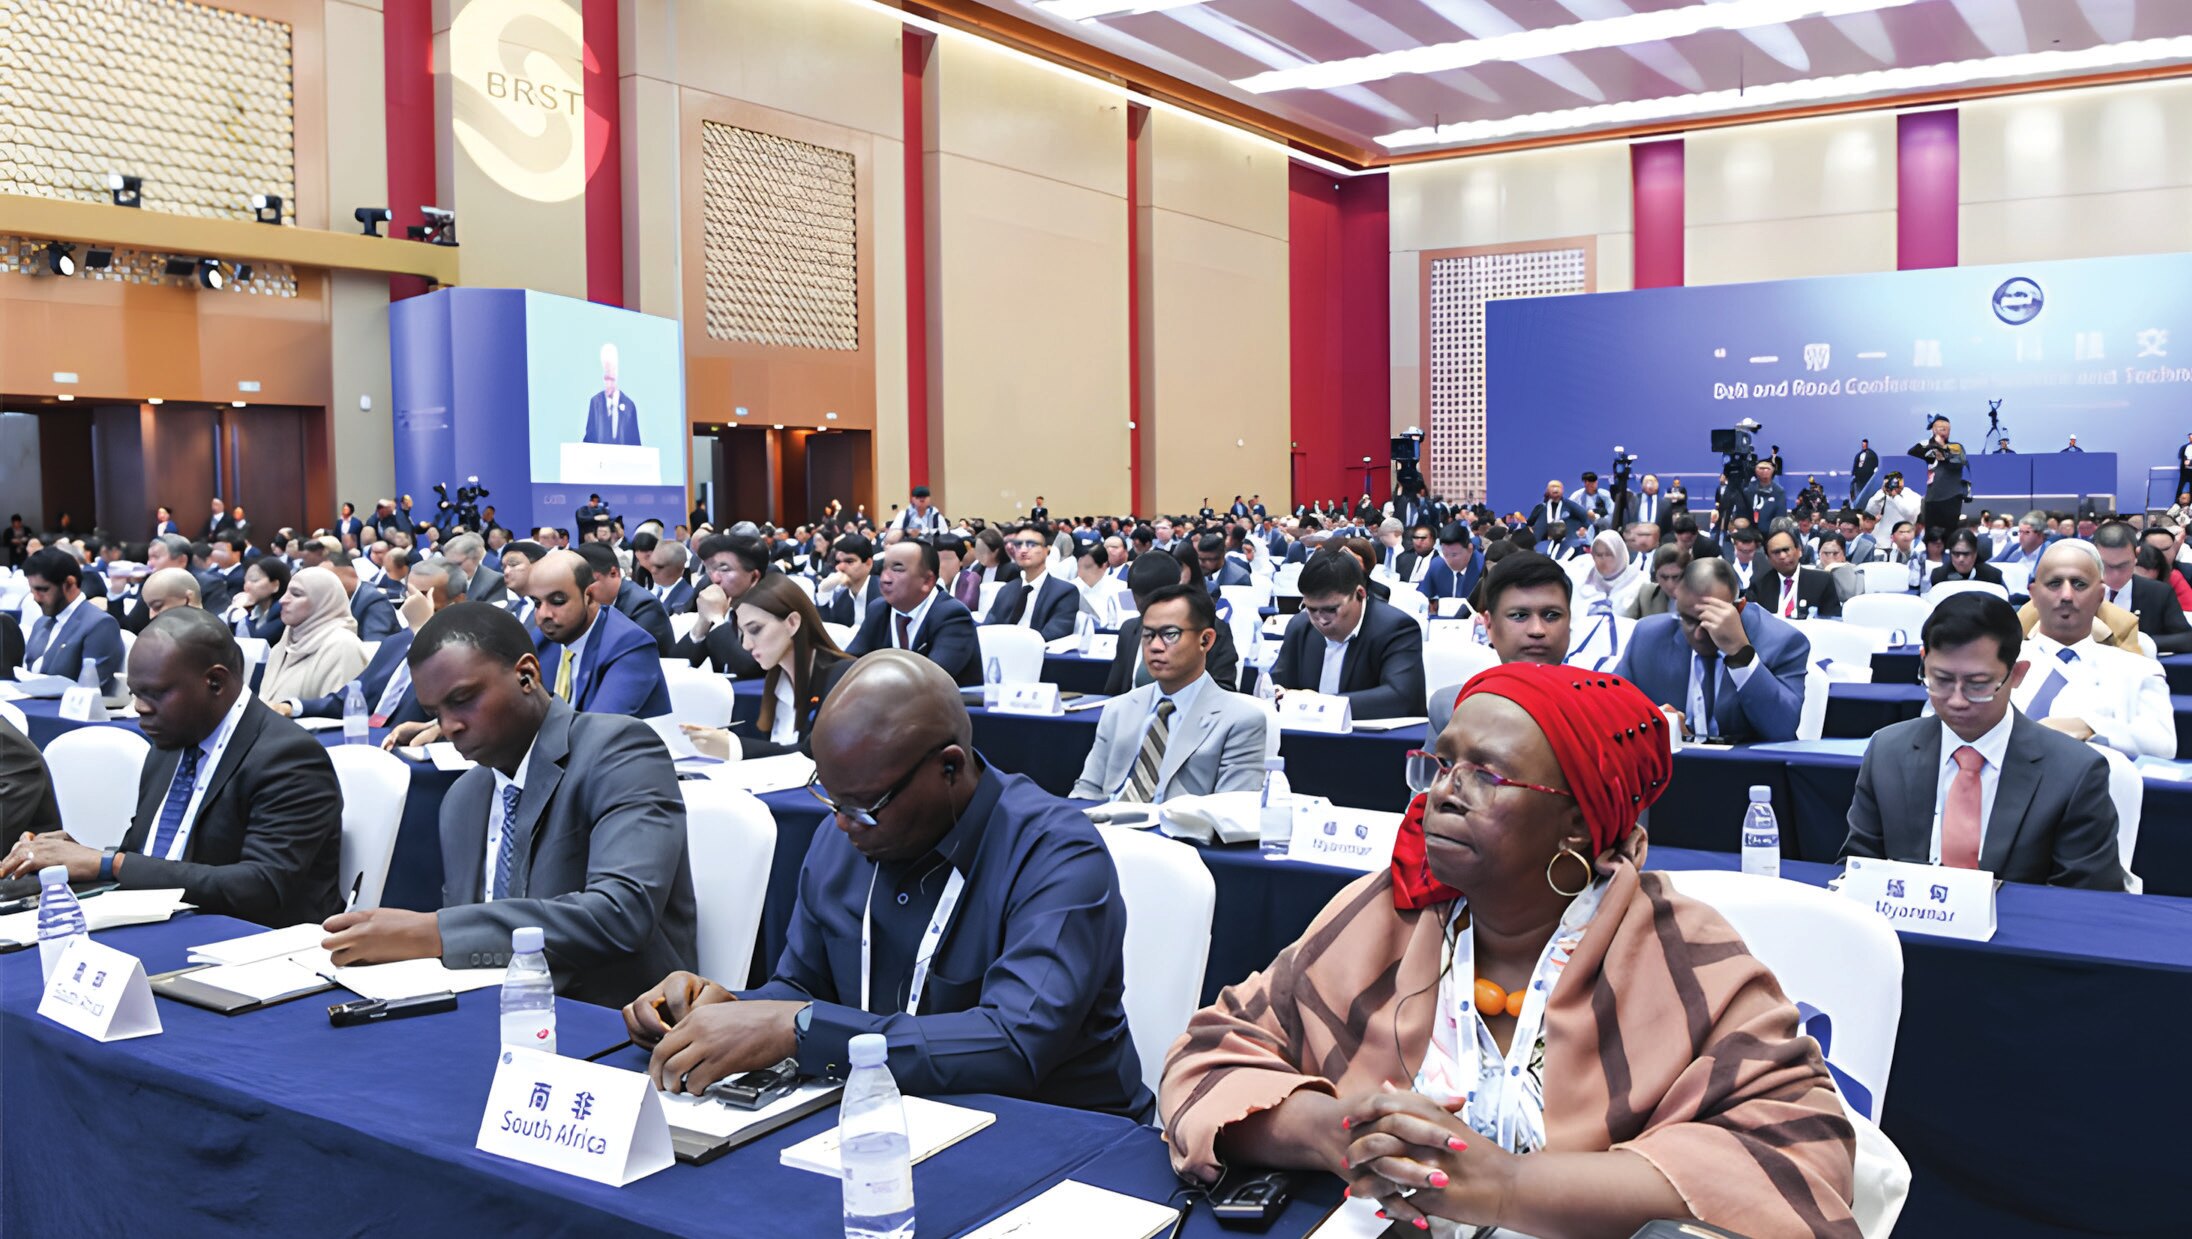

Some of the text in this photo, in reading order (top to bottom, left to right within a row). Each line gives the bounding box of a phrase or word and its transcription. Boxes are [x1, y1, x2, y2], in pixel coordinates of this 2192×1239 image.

[486, 71, 584, 116] BRST
[500, 1110, 607, 1155] South Africa
